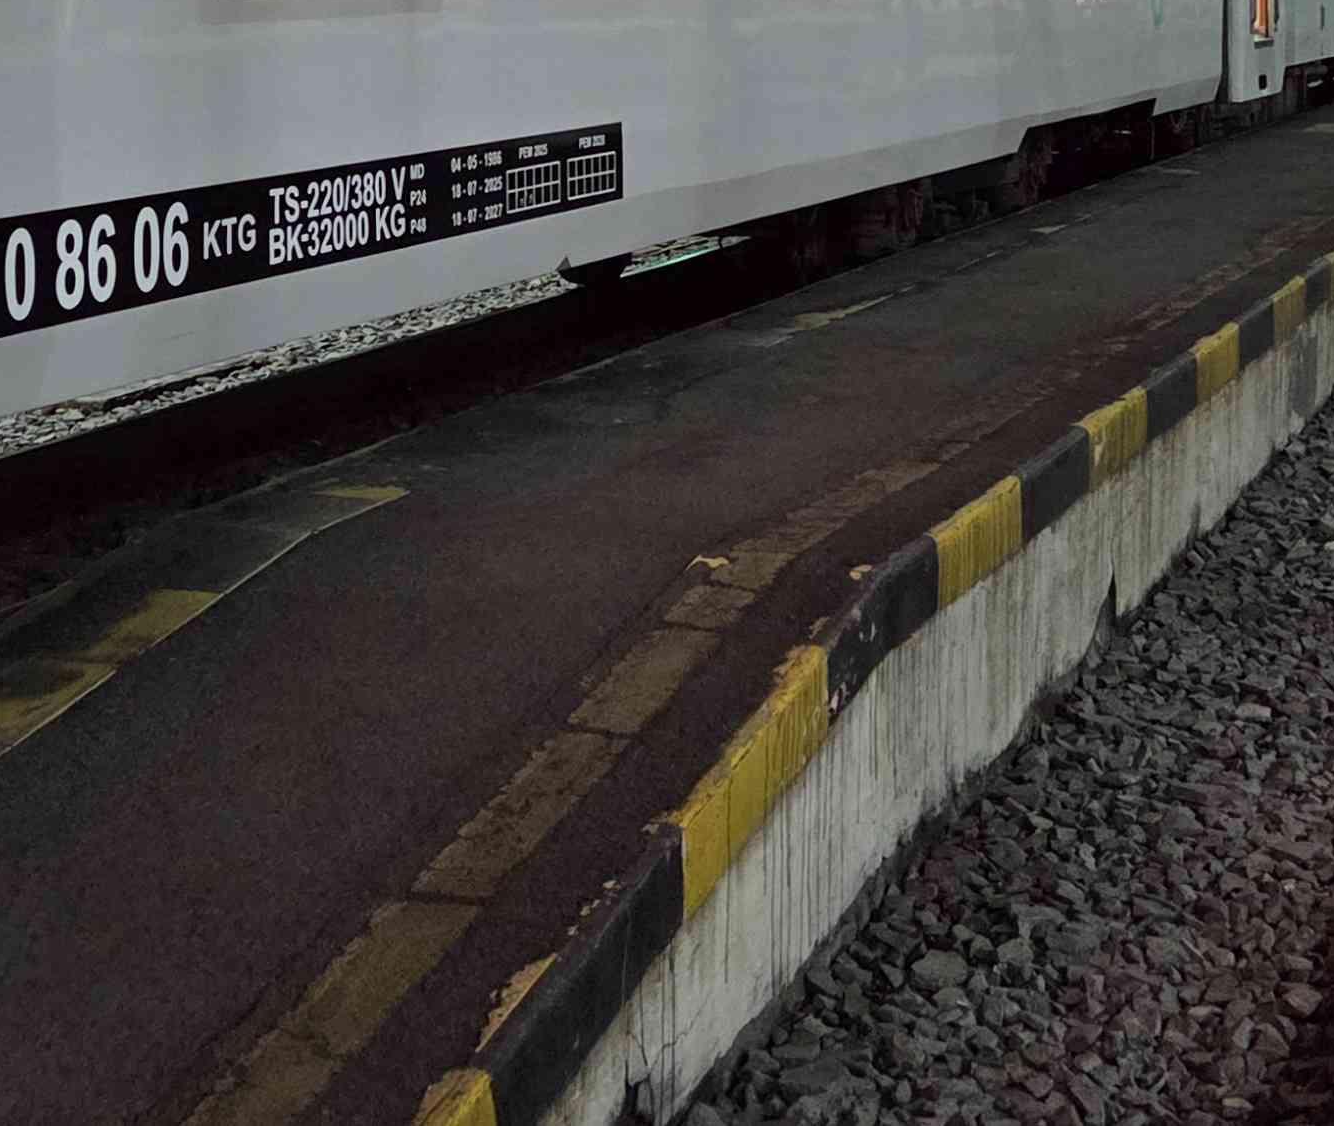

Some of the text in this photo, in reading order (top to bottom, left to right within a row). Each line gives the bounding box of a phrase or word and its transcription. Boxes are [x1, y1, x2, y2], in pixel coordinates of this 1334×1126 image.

[269, 167, 406, 226] TS-220/380 V
[410, 190, 427, 206] P24
[5, 227, 36, 322] 0
[55, 213, 117, 310] 86
[133, 201, 190, 294] 06
[202, 215, 257, 261] KTG
[268, 204, 406, 266] BK-32000 KG
